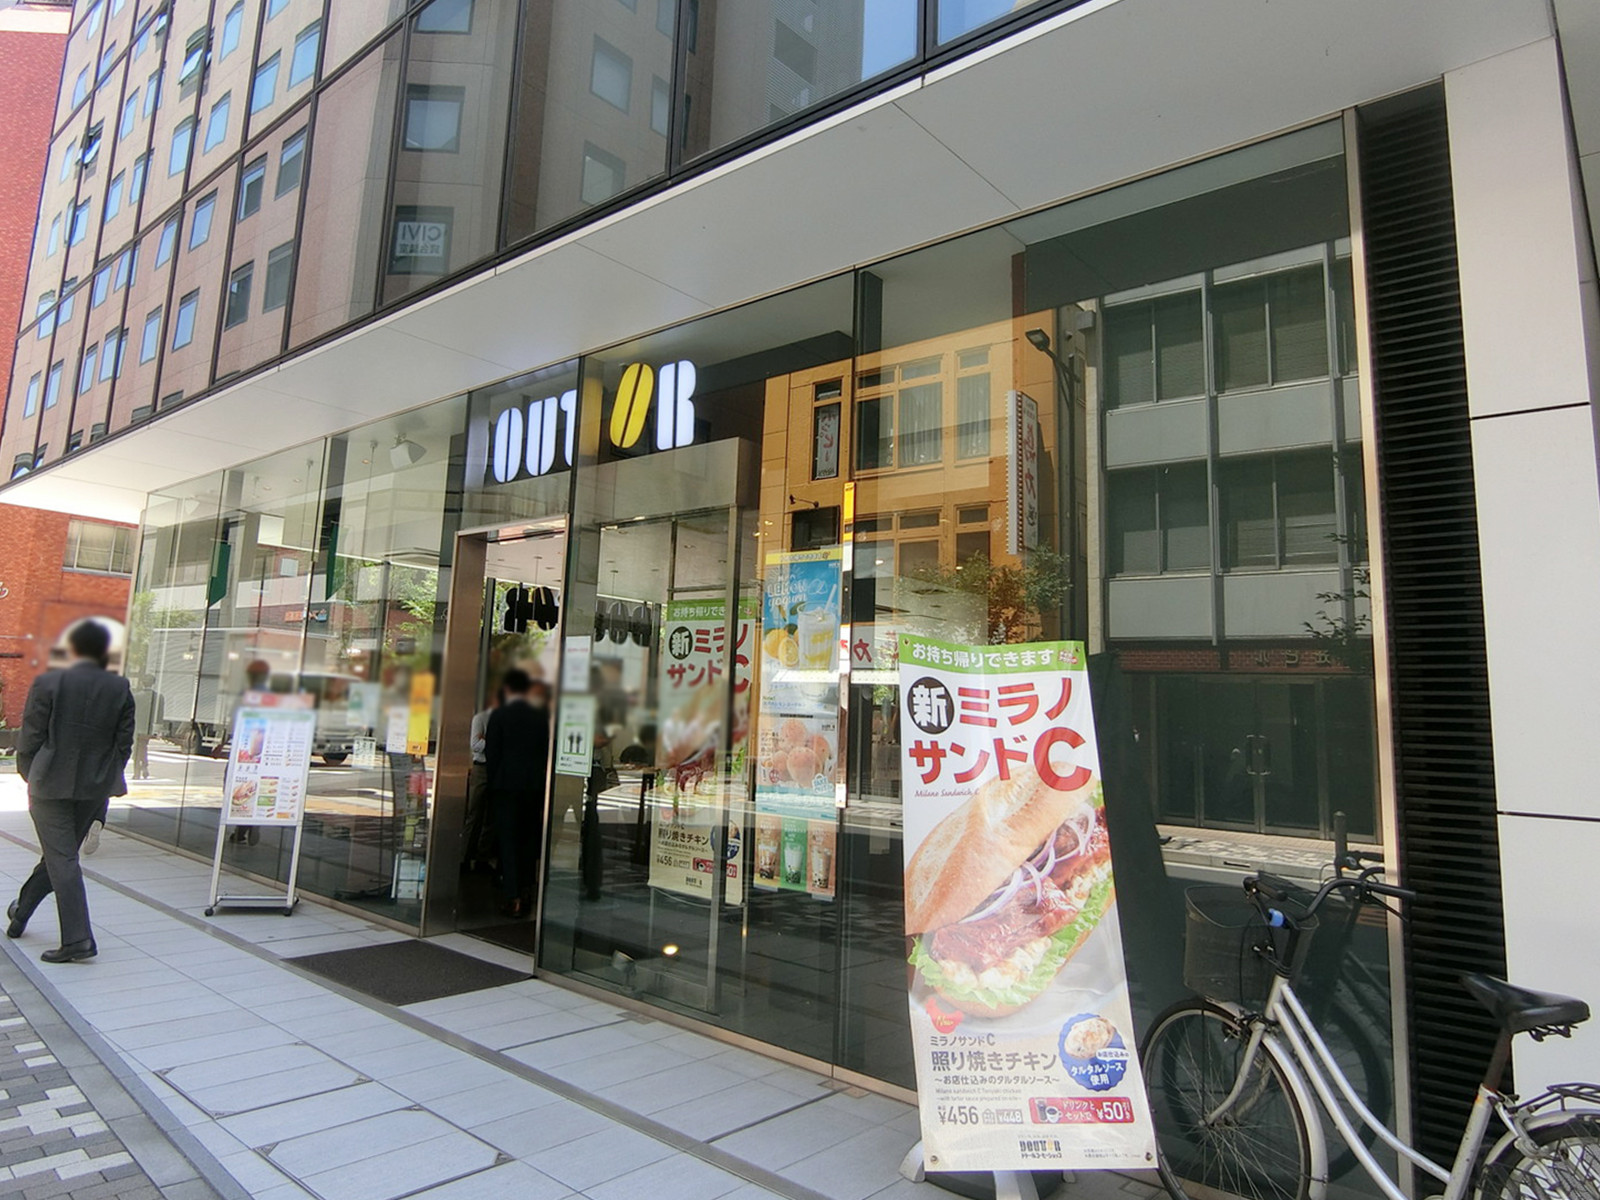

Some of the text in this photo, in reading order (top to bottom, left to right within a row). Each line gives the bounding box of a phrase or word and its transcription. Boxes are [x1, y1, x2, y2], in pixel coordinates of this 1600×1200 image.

[671, 630, 690, 657] 新
[912, 642, 1054, 669] お持ち帰りできます
[912, 677, 1072, 728] 新 ミラノ
[930, 1033, 996, 1047] ミラノサンドC
[931, 1051, 1058, 1072] 照り焼きチキン
[1071, 1063, 1124, 1076] タルタルソース
[1090, 1074, 1110, 1085] 使用
[1063, 1100, 1096, 1110] ドリンクと
[938, 1105, 979, 1125] ¥456
[1065, 1110, 1093, 1120] セットで
